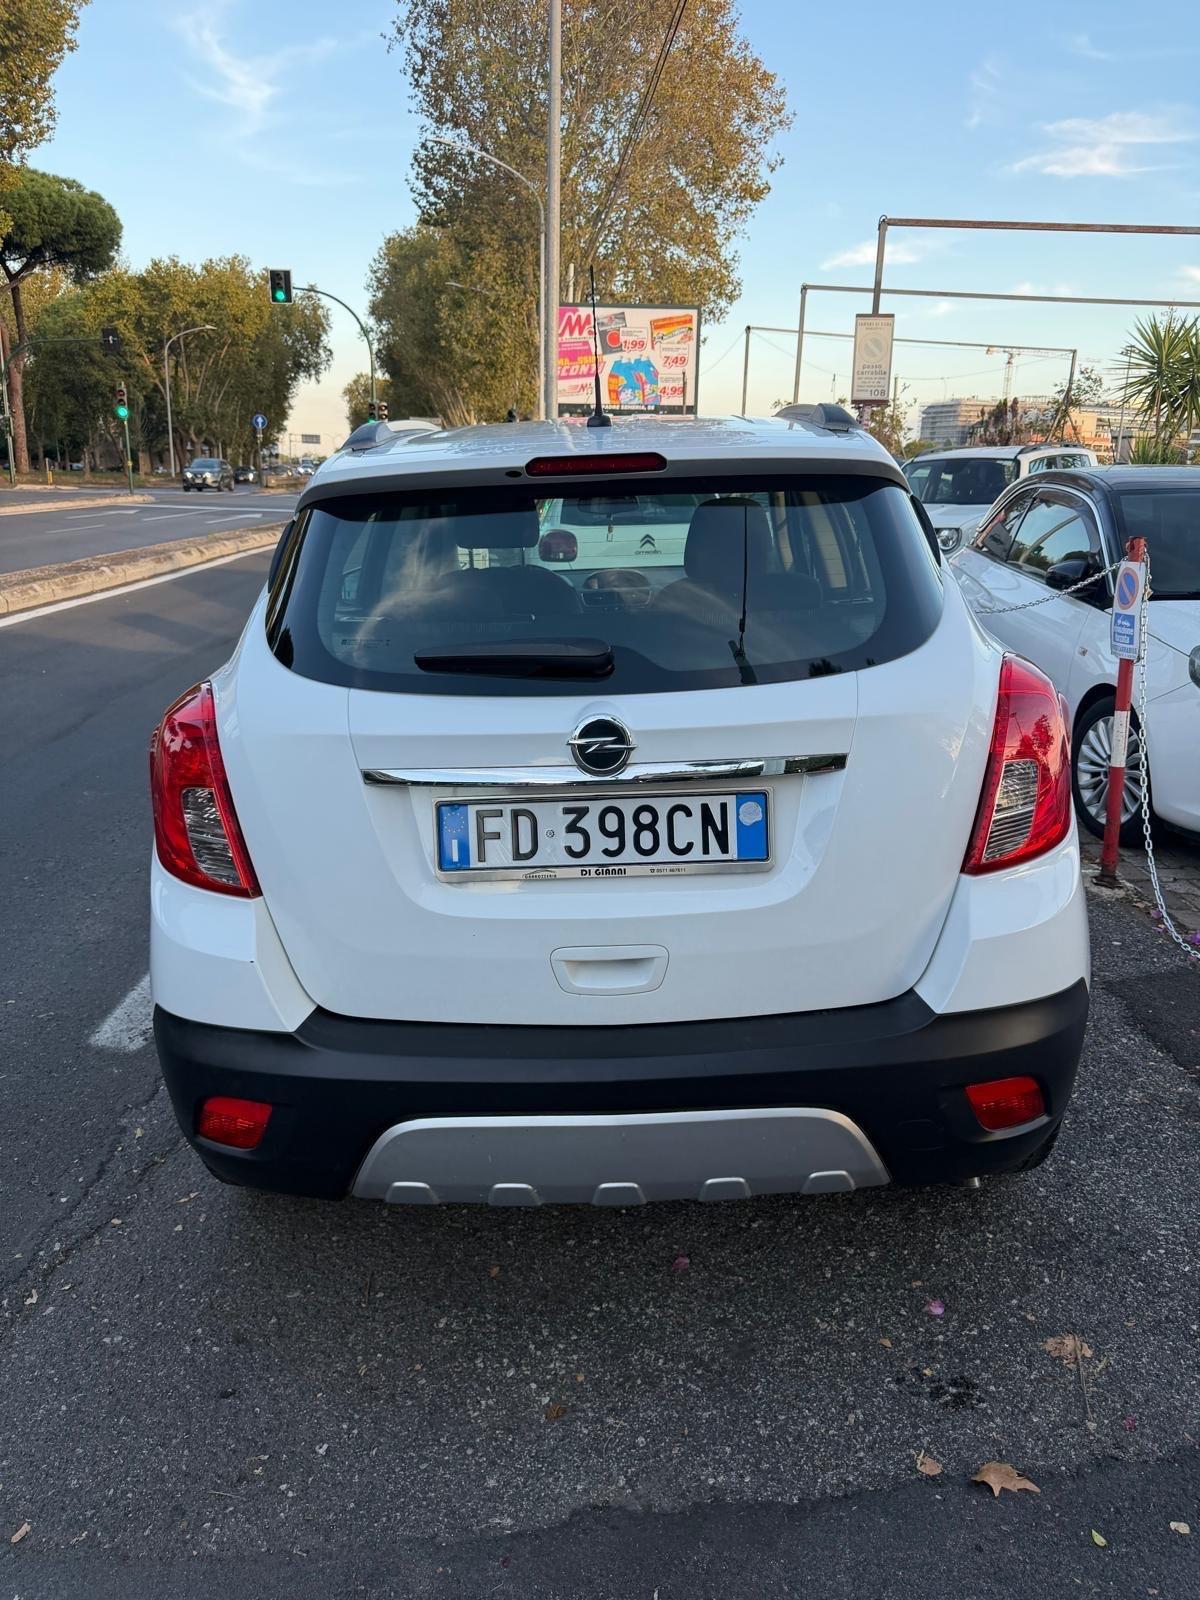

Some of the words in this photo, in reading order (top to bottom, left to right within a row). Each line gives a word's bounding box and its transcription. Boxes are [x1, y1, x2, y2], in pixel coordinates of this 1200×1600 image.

[622, 340, 645, 352] 1,99
[663, 355, 686, 367] 7,49
[870, 388, 886, 397] 108
[475, 808, 539, 863] FD
[562, 801, 730, 859] 398CN
[580, 868, 591, 876] DI
[594, 867, 627, 876] GIANNI
